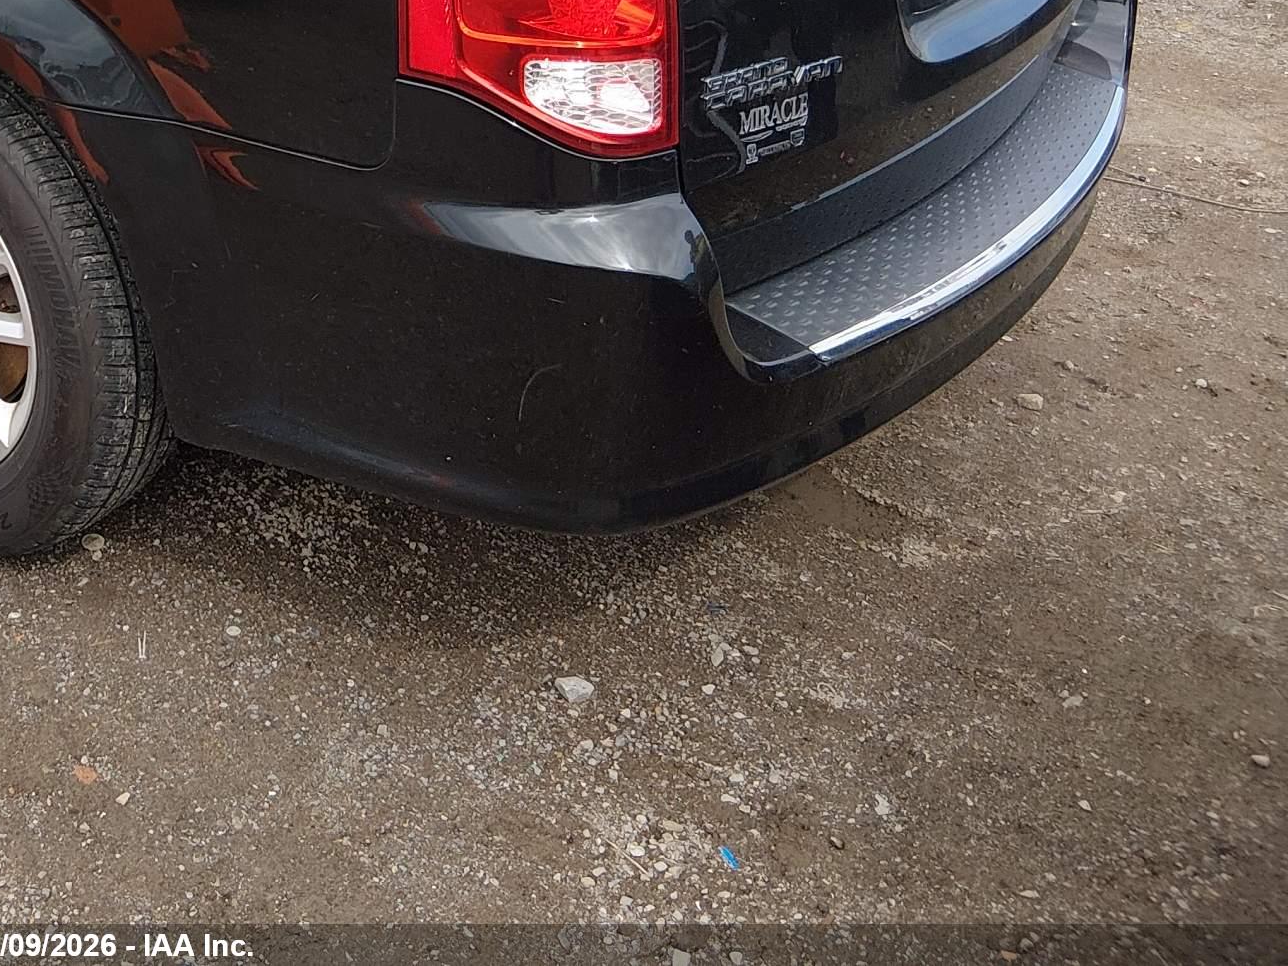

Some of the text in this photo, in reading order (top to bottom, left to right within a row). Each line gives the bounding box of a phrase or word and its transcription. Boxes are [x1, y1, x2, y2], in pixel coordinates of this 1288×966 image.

[701, 56, 788, 92] GRAND
[701, 56, 843, 109] CARAVAN
[739, 92, 809, 135] MIRACLE
